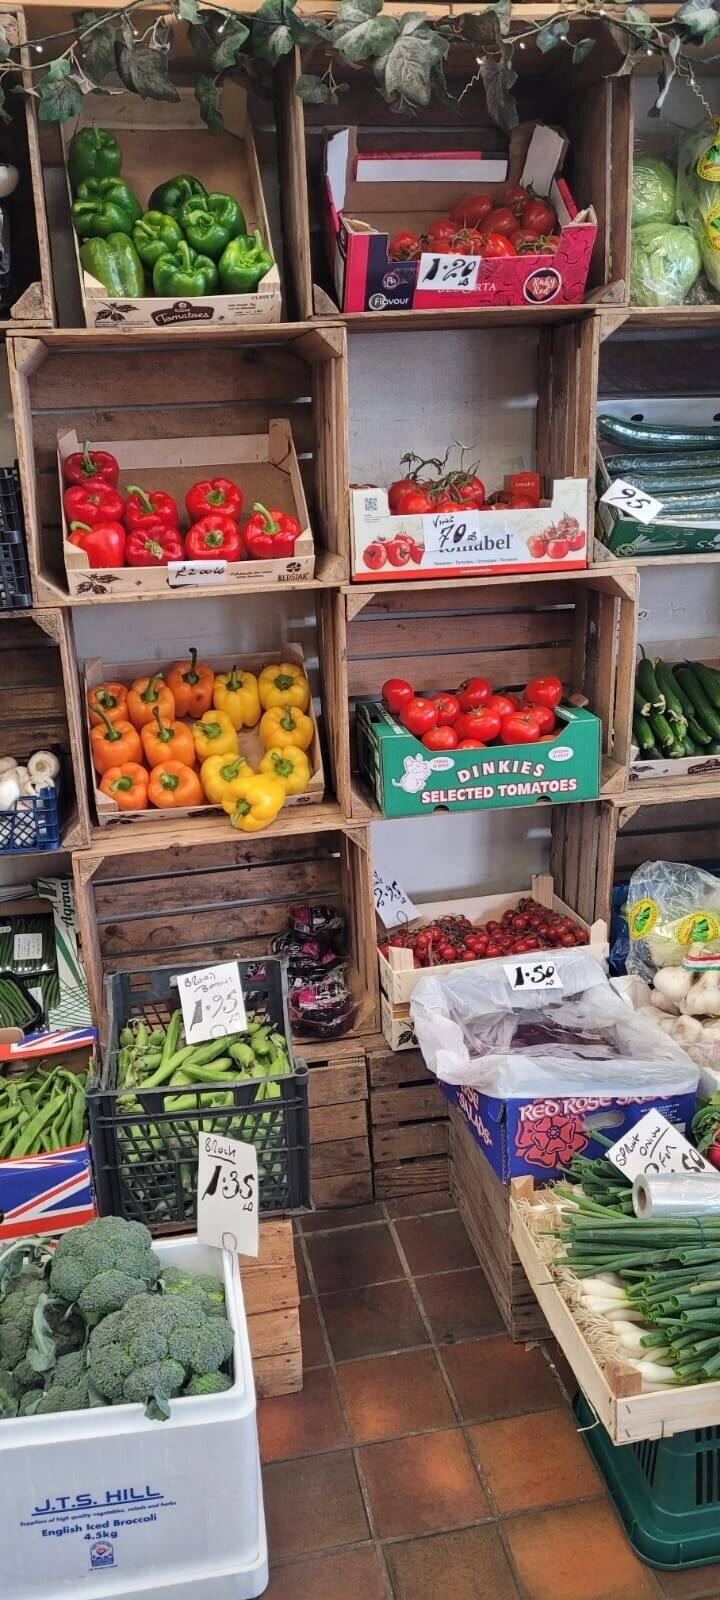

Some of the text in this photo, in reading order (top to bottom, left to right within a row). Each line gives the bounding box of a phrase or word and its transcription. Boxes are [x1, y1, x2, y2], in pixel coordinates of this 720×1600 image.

[422, 257, 477, 283] 1.20
[532, 275, 557, 290] Ruby
[532, 285, 551, 296] Red
[374, 296, 410, 306] Flavour
[155, 311, 210, 323] Tomatoes
[608, 488, 651, 509] 95
[438, 523, 467, 549] 70
[439, 533, 511, 553] abel
[278, 572, 309, 582] REDSTAR
[456, 759, 545, 784] DINKIES
[421, 778, 578, 804] SELECTED TOMATOES
[373, 880, 402, 908] 2.95
[513, 964, 555, 988] 1.50
[189, 989, 239, 1032] 1.95
[518, 1098, 560, 1122] RED
[202, 1165, 255, 1201] 1.35
[34, 1485, 160, 1513] J.T.S. HILL
[19, 1519, 47, 1527] Suppliers
[127, 1504, 147, 1512] salads
[41, 1513, 157, 1538] English Iced Broccoli
[83, 1530, 118, 1541] 4.5kg
